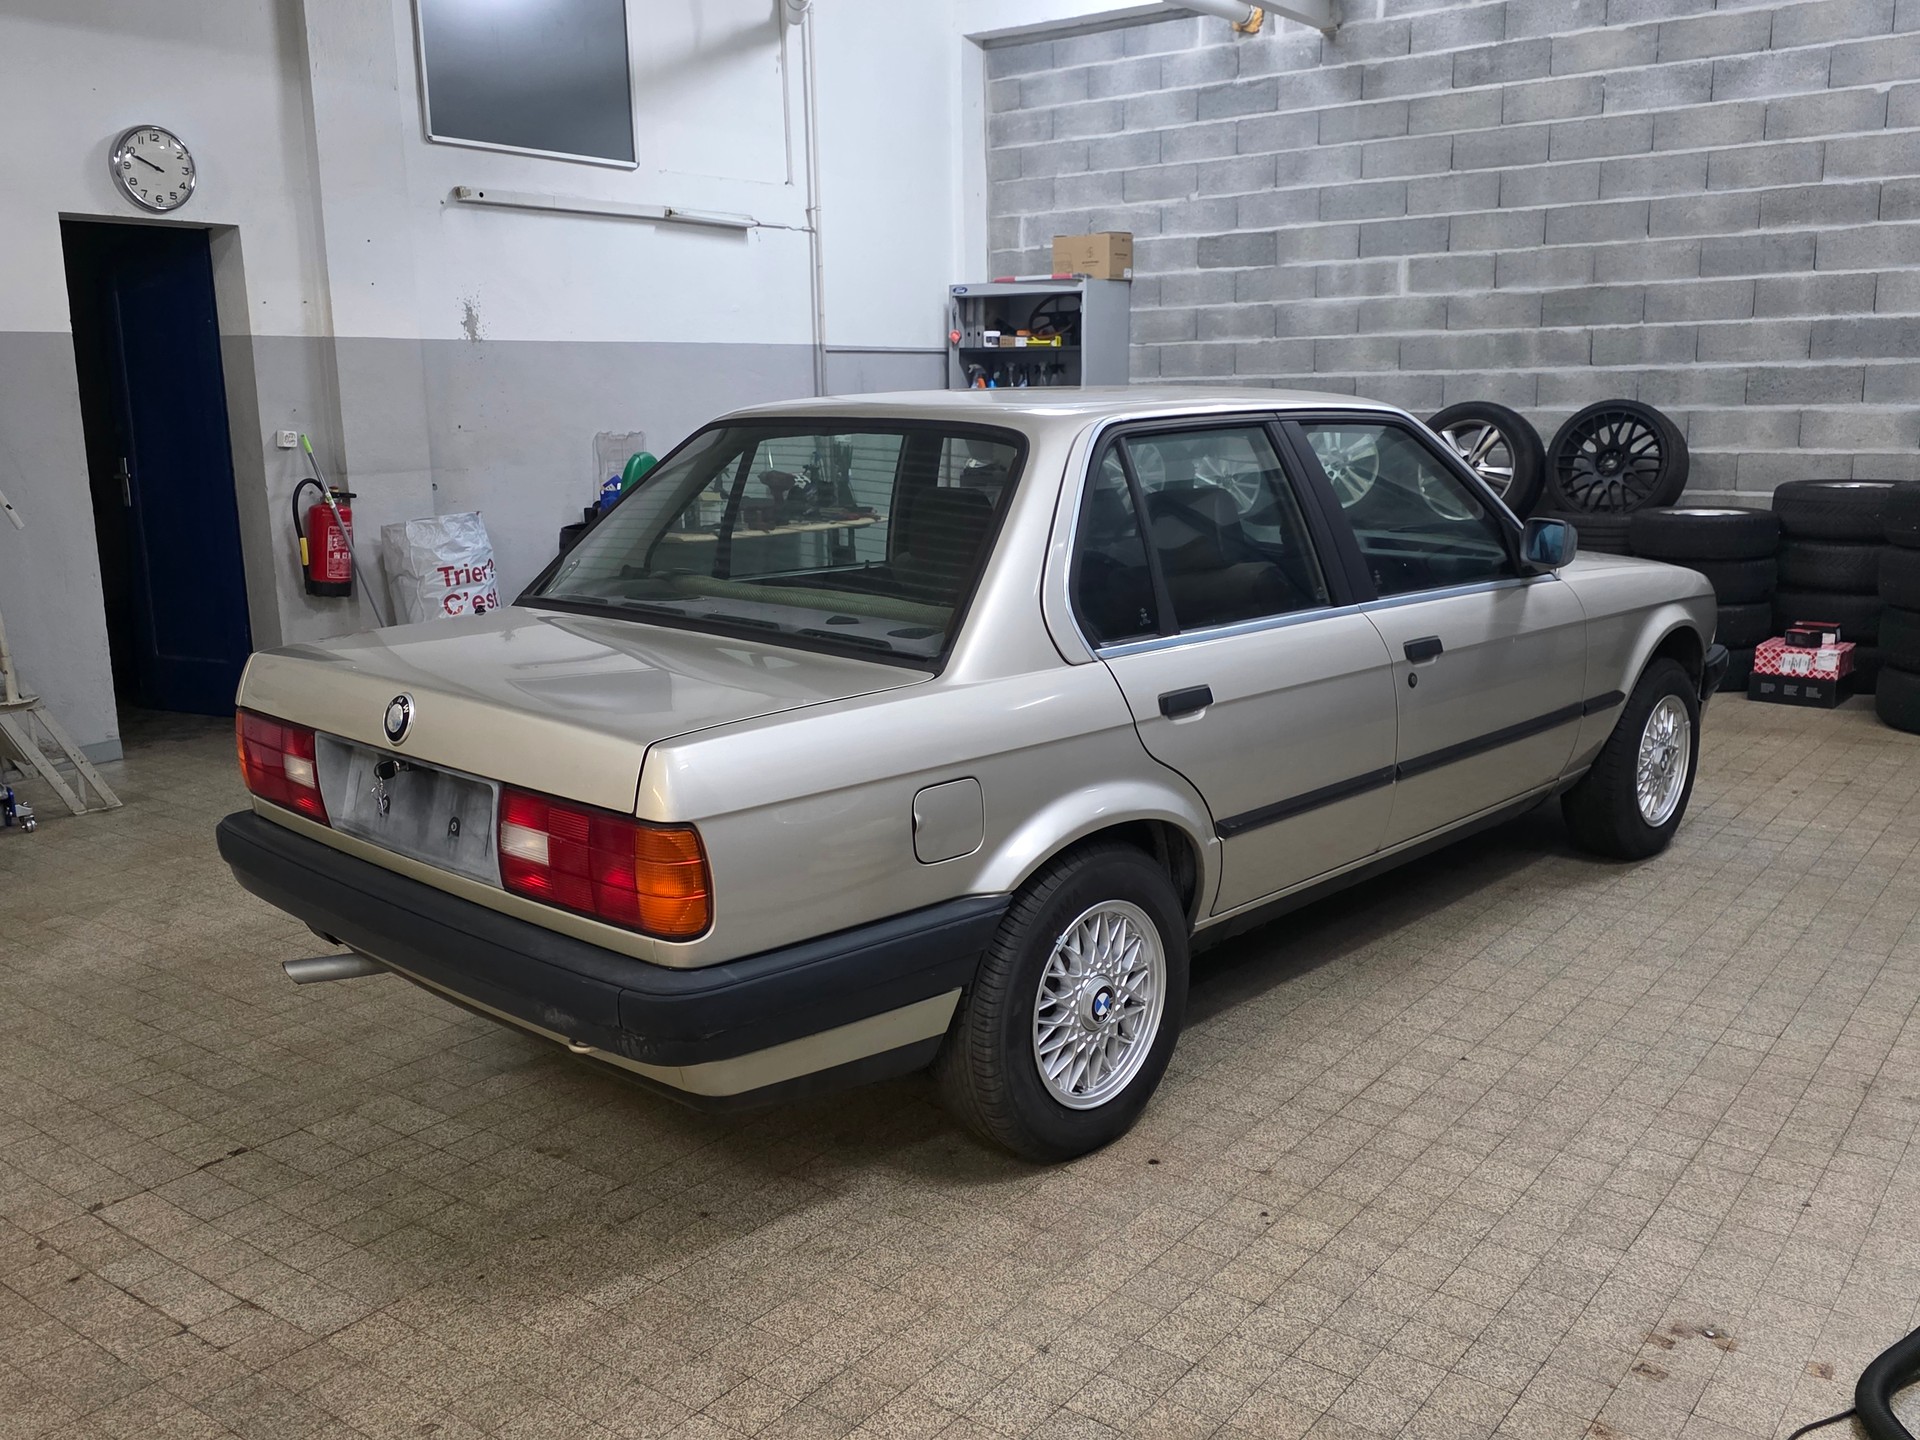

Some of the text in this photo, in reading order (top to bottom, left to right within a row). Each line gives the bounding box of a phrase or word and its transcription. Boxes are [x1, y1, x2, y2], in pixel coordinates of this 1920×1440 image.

[138, 135, 144, 144] 11
[150, 133, 159, 142] 12
[125, 146, 135, 154] 10
[182, 167, 189, 175] 3
[141, 190, 147, 198] 7
[170, 192, 177, 200] 5
[156, 195, 163, 203] 6
[437, 559, 494, 587] Trier?
[443, 588, 498, 616] C'est
